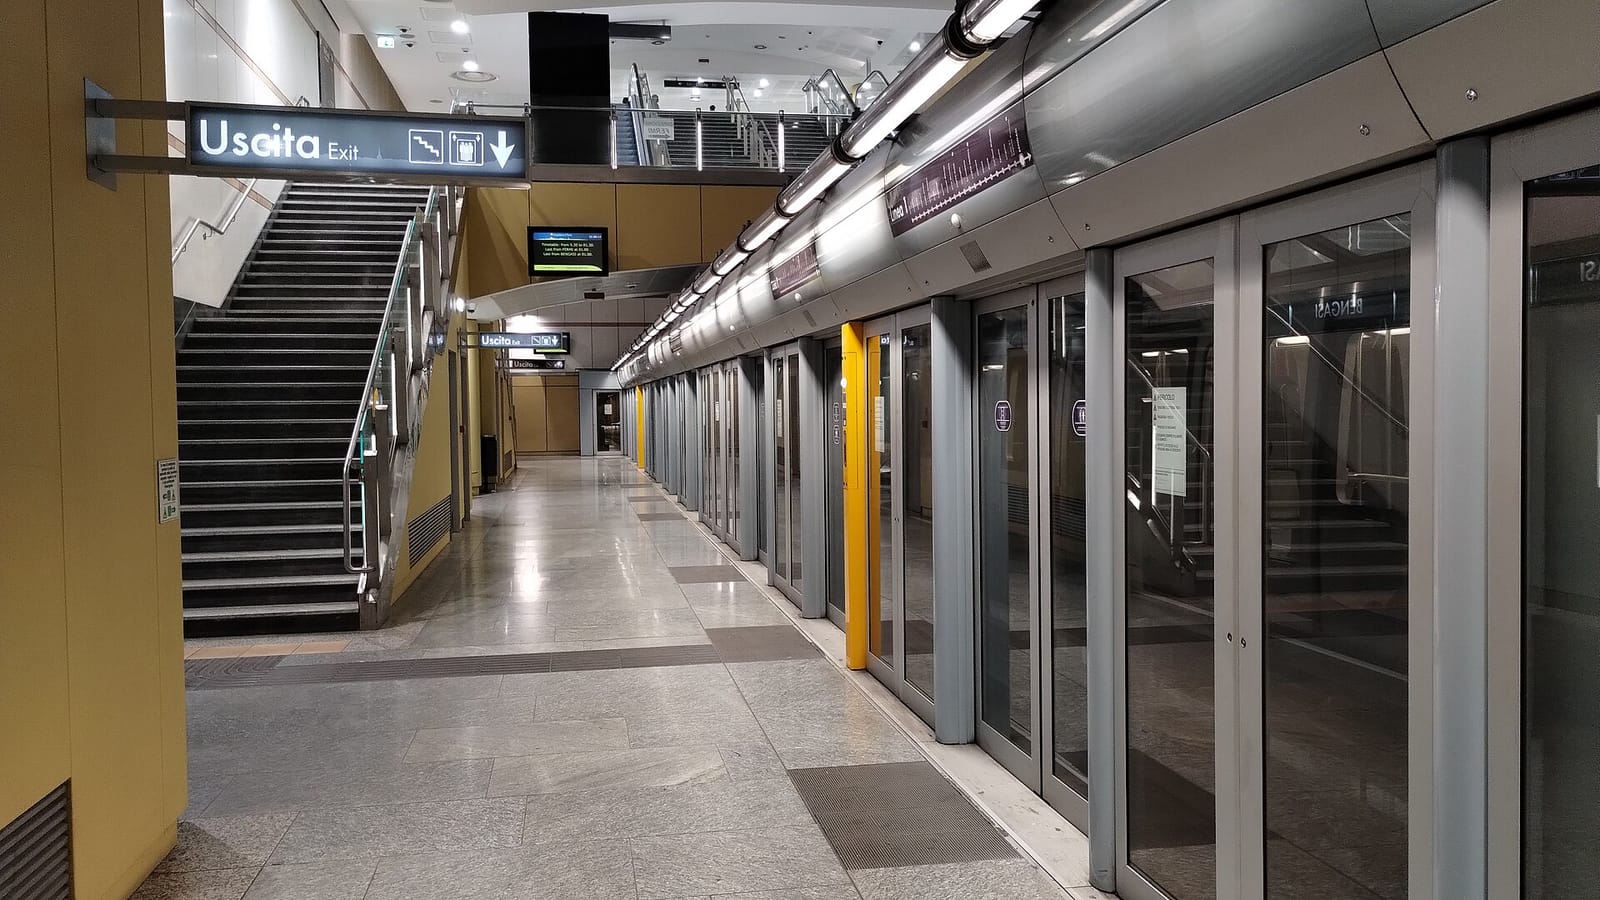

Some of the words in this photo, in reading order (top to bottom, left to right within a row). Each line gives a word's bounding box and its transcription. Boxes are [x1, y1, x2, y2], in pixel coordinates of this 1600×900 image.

[199, 119, 320, 159] Uscita
[327, 142, 359, 161] Exit
[481, 335, 512, 345] Uscita
